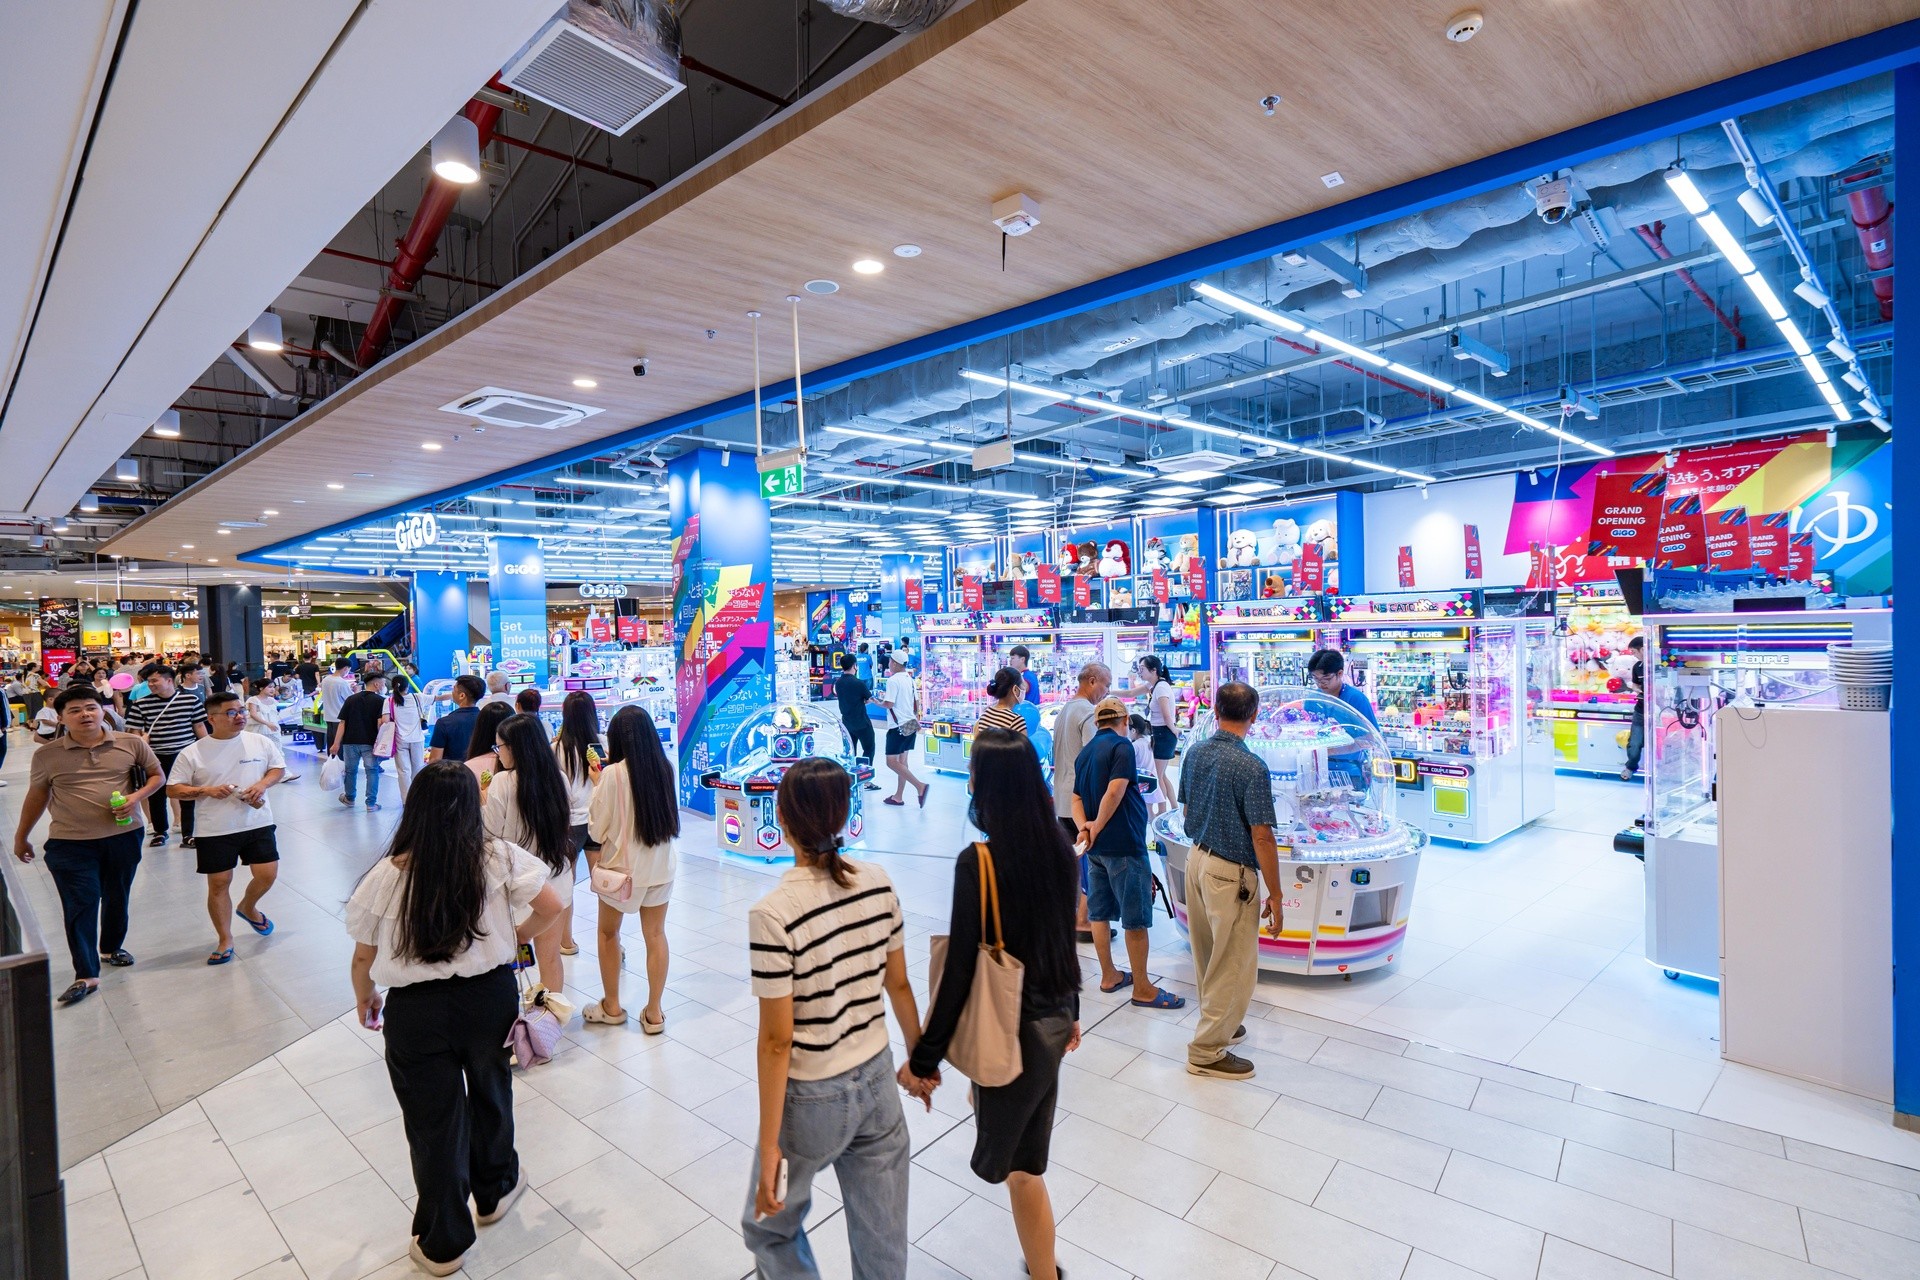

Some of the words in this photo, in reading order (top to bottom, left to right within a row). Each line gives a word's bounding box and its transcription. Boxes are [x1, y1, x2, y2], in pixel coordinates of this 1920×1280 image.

[1598, 517, 1646, 525] OPENING
[395, 512, 437, 551] GiGO
[1660, 524, 1685, 534] RAND
[504, 564, 540, 575] GiGO
[300, 598, 309, 606] 1F
[500, 622, 522, 631] Get
[503, 634, 527, 644] into
[529, 634, 547, 644] the
[1745, 655, 1789, 664] COUPLE
[1294, 899, 1300, 908] 5
